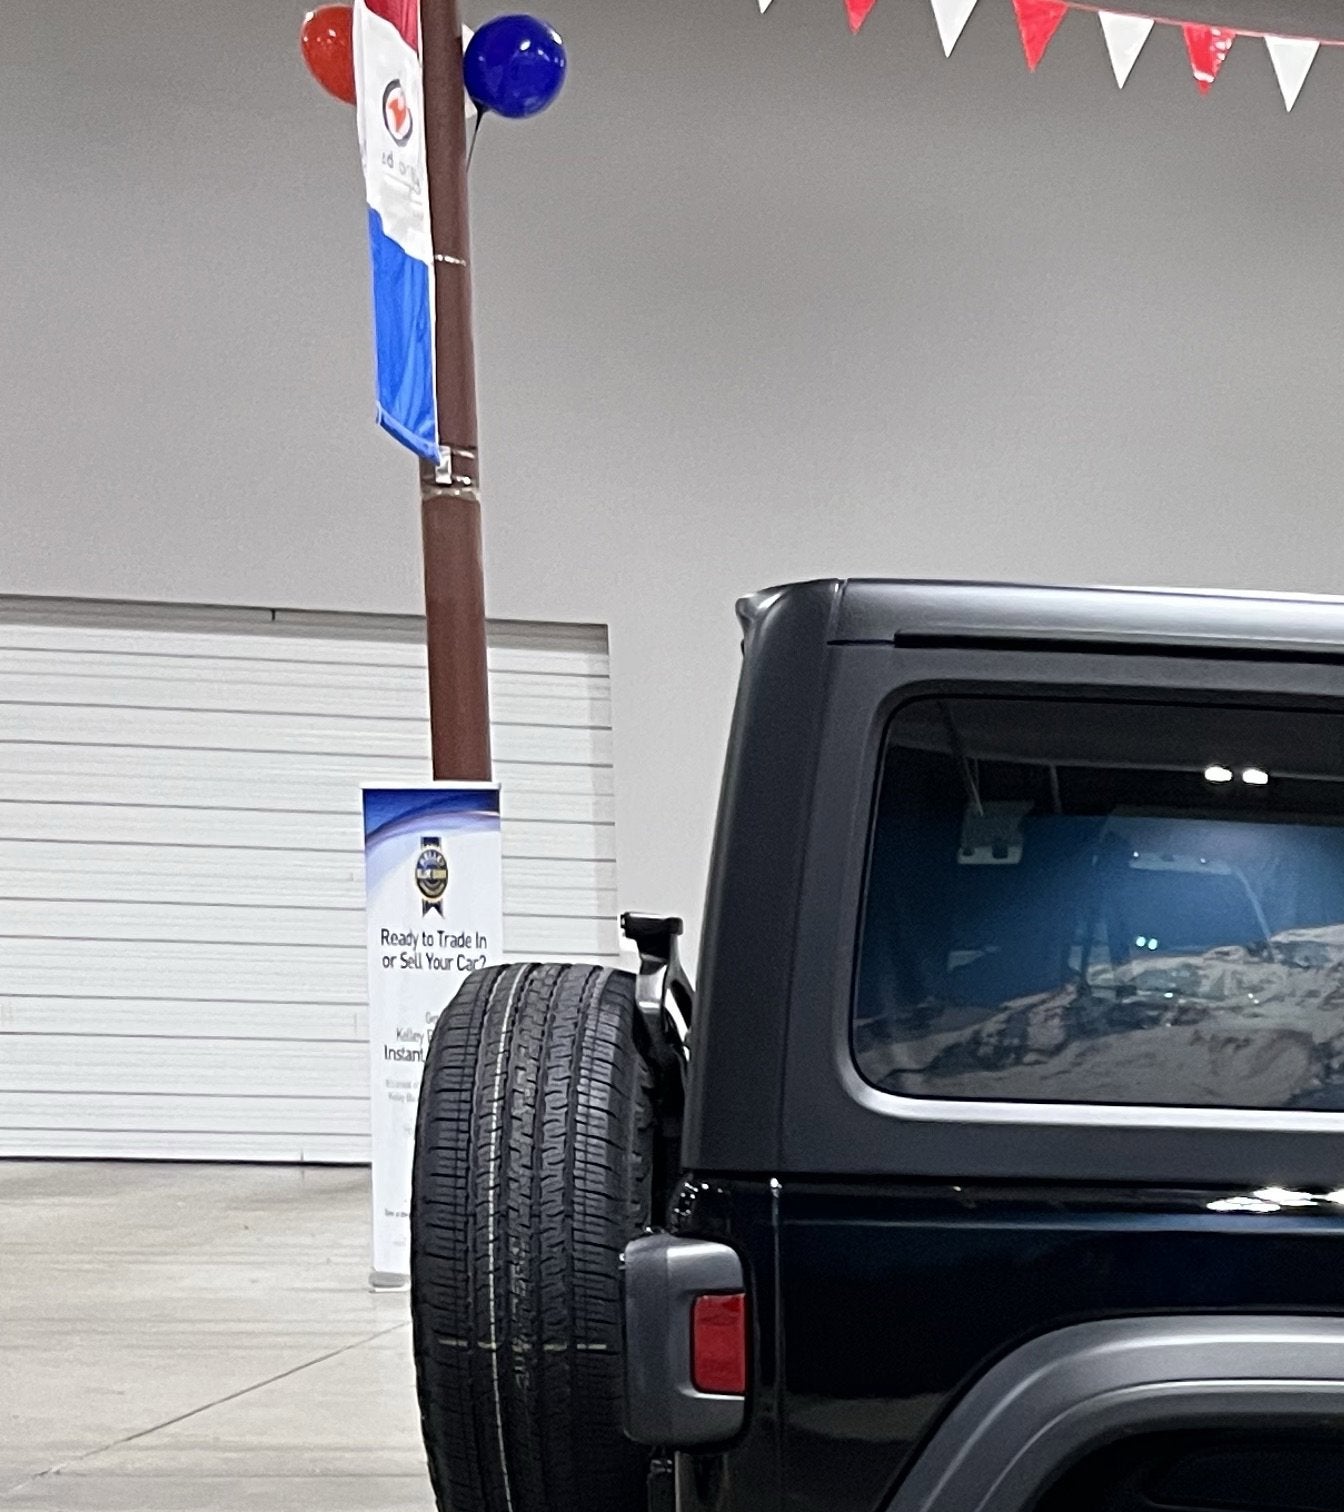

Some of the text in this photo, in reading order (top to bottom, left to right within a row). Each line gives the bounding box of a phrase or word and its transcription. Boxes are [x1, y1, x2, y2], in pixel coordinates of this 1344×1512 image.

[380, 928, 488, 951] Ready to Trade In
[381, 951, 487, 972] or Sell Your Car?
